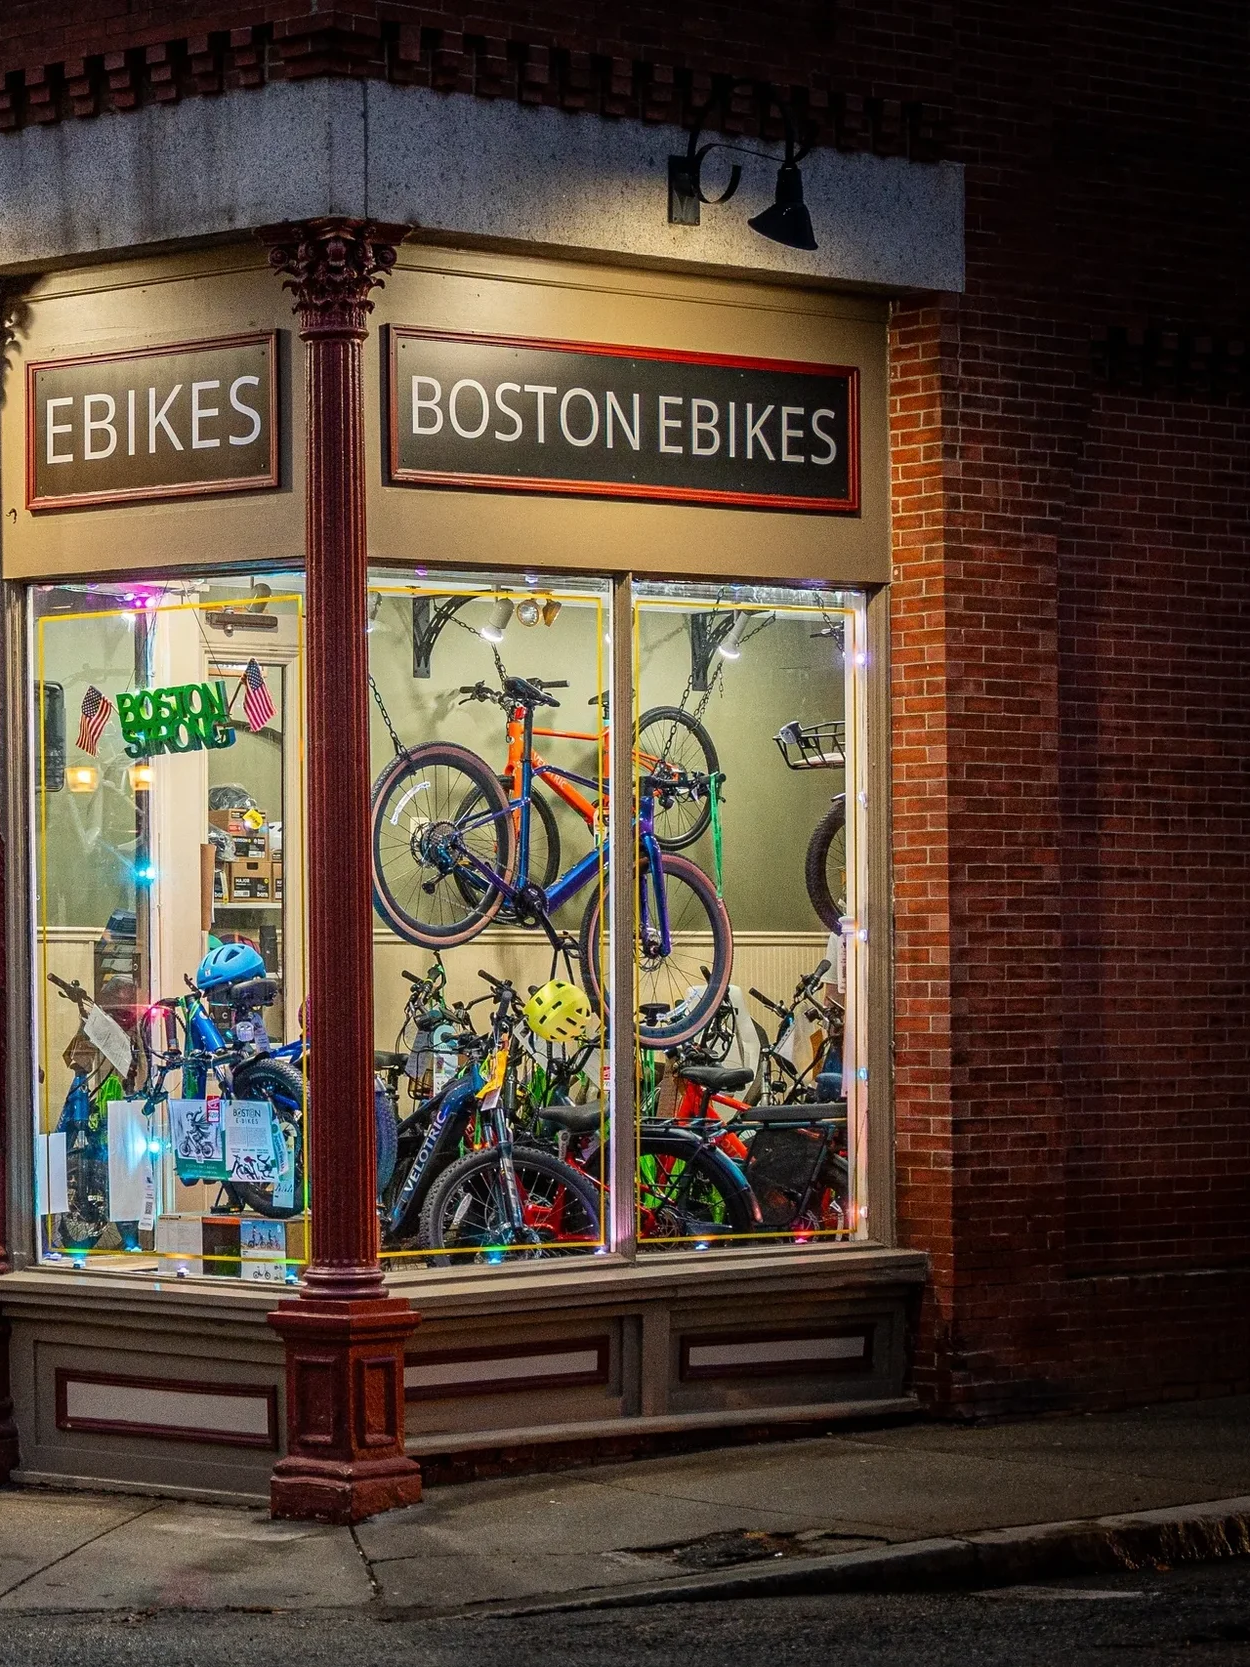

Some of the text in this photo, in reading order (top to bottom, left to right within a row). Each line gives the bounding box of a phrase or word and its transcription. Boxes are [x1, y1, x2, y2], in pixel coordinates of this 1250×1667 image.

[46, 375, 262, 465] EBIKES
[411, 375, 837, 465] BOSTON EBIKES
[116, 681, 228, 728] BOSTON
[122, 717, 237, 758] STRONG
[533, 751, 567, 790] VERIC
[232, 1107, 261, 1118] BOSTON
[404, 1104, 448, 1192] VELOTRIC
